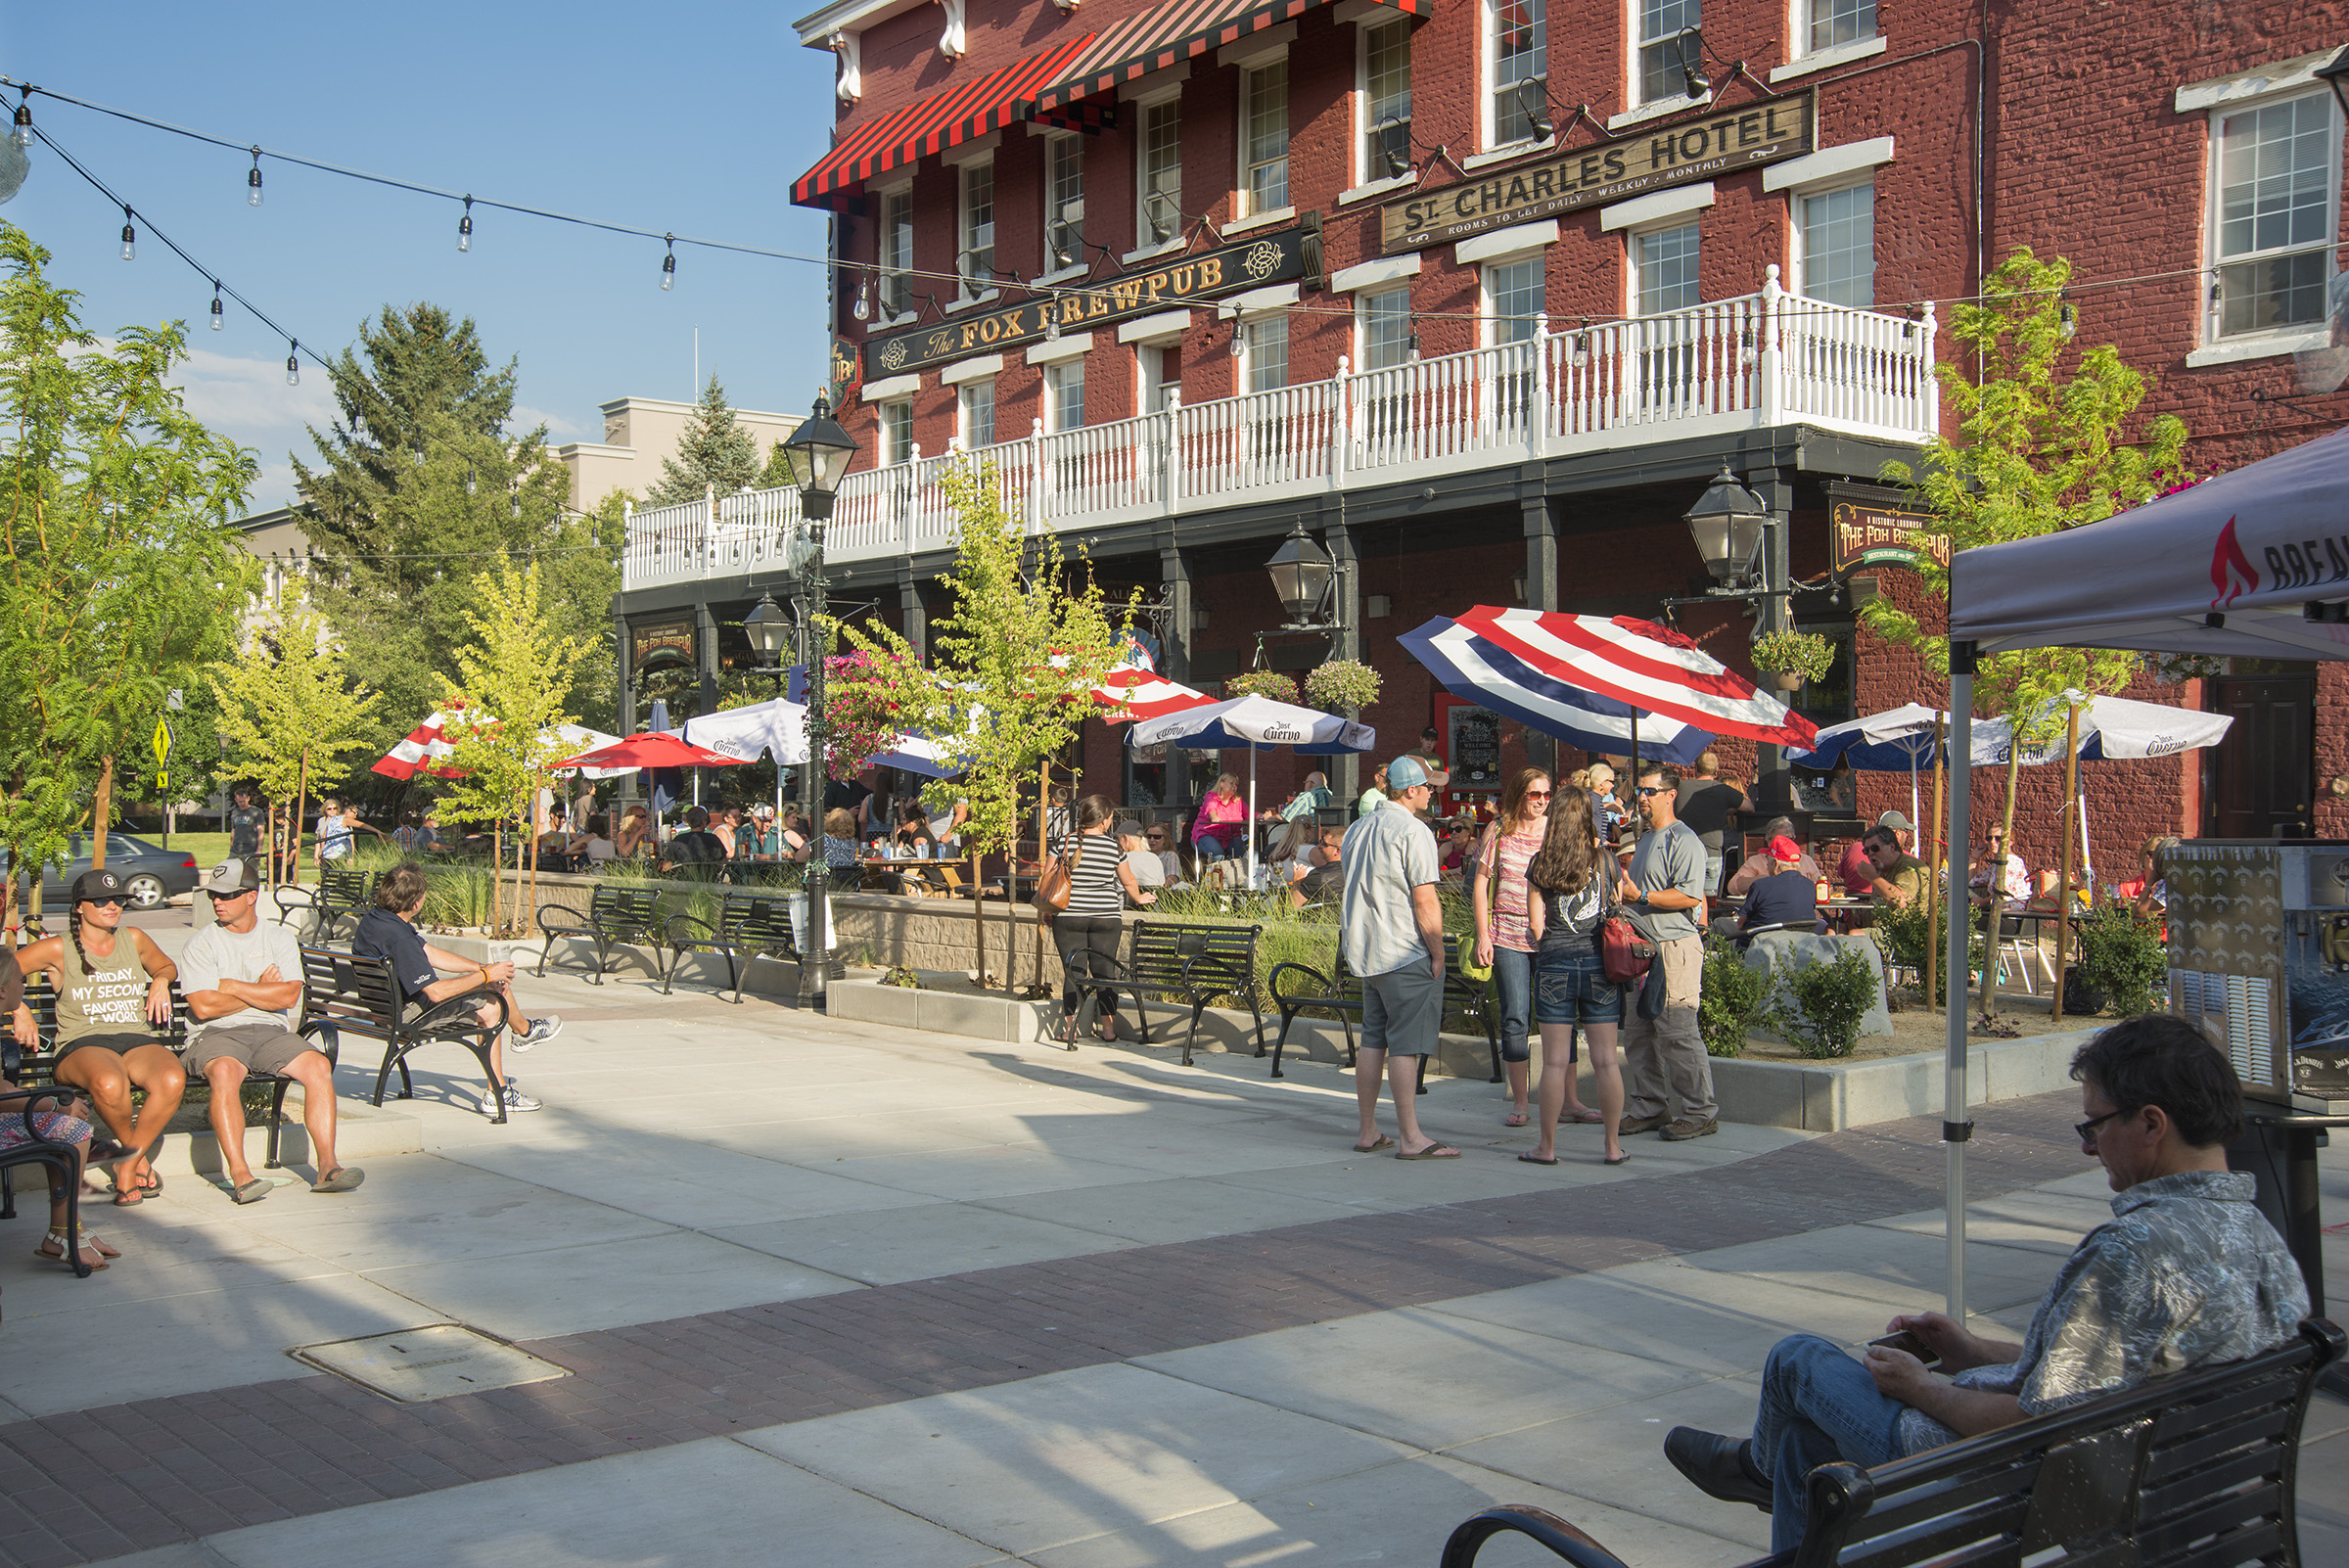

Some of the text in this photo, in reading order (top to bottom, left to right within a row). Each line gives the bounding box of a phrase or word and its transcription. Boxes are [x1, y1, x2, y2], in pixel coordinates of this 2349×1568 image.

[1454, 149, 1627, 218] CHARLES
[1651, 108, 1787, 169] HOTEL
[1449, 218, 1488, 235] ROOMS
[1517, 206, 1539, 218] LET
[1547, 194, 1583, 210] DAILY
[1598, 177, 1648, 197] WEEKLY
[1666, 158, 1727, 180] MONTHLY
[924, 257, 1222, 358] The FOX BREWPUB
[832, 359, 851, 384] UB
[1872, 516, 1896, 527] HISTORIC
[1840, 523, 1864, 558] THE
[1893, 529, 1950, 568] BRPUB
[637, 639, 649, 659] THE
[663, 633, 691, 655] BREWPUB
[1263, 726, 1301, 741] Cuervo
[1276, 721, 1292, 730] Jose
[1905, 719, 1936, 732] Cuerv
[713, 739, 741, 757] Cuervo
[2145, 740, 2188, 757] Cuervo
[88, 967, 137, 983] FRIDAY.
[71, 983, 146, 1001] MY SECOND
[82, 999, 140, 1016] FAVORITE
[101, 1011, 142, 1024] WORD.
